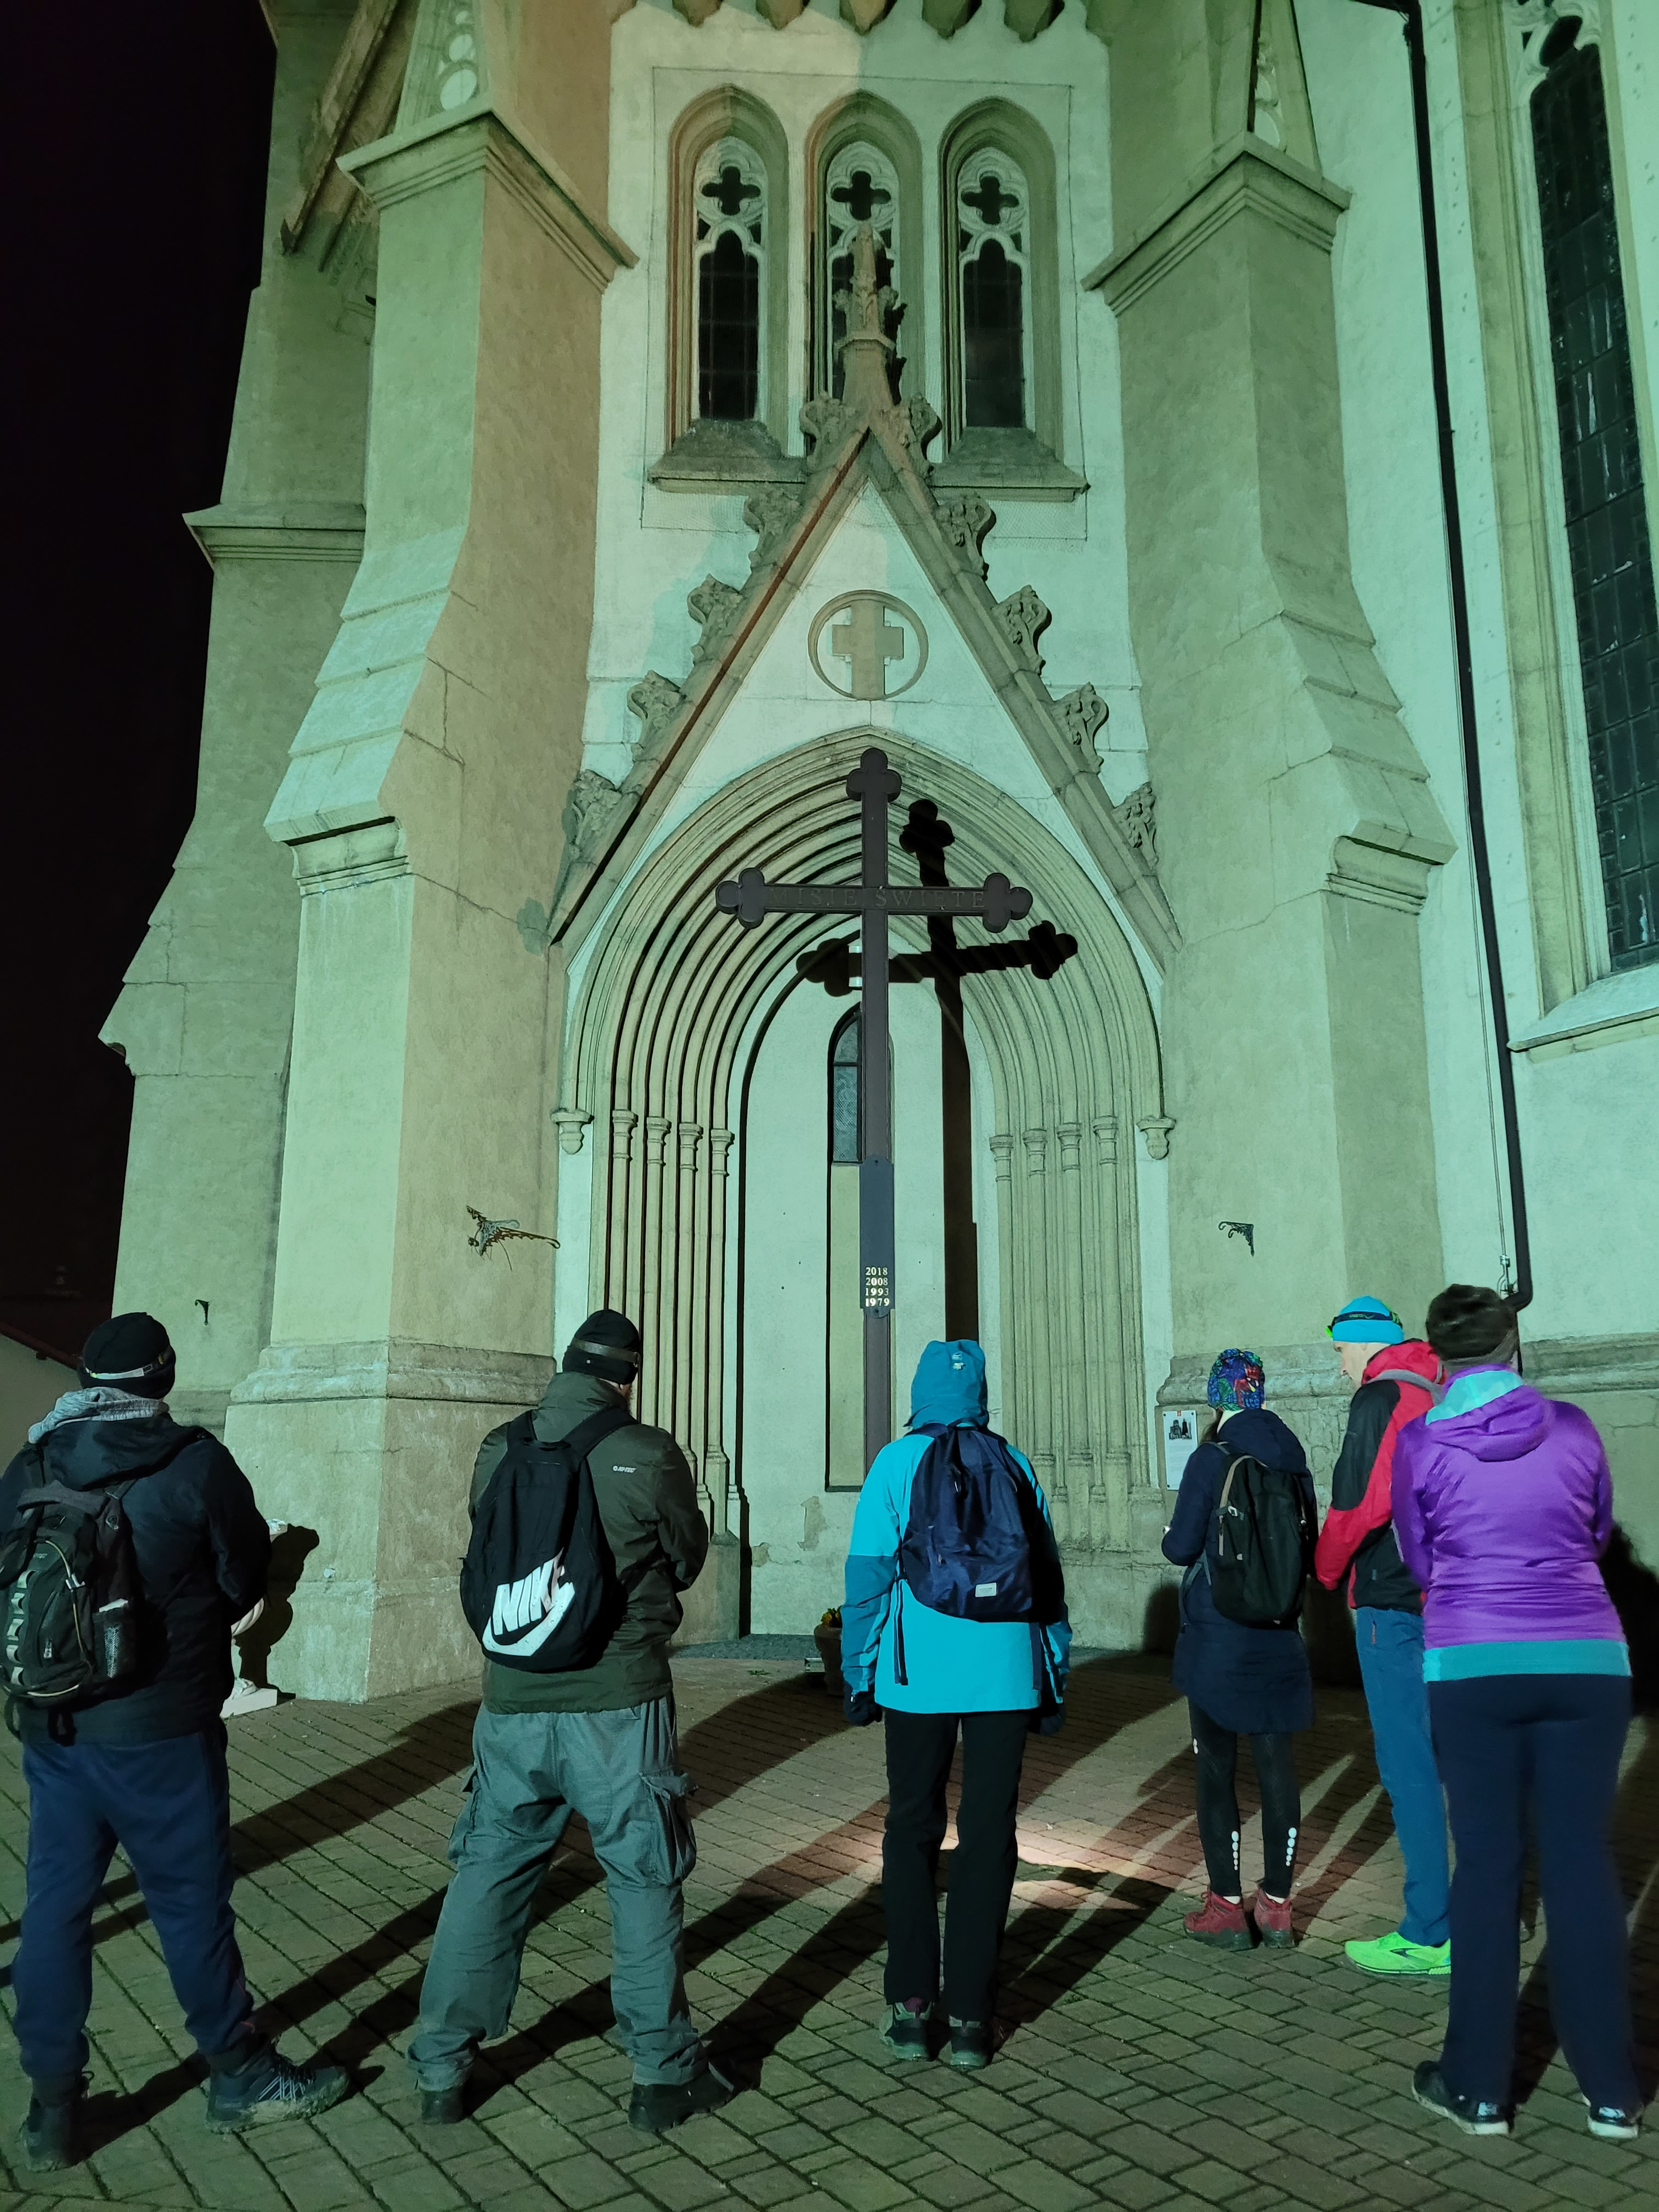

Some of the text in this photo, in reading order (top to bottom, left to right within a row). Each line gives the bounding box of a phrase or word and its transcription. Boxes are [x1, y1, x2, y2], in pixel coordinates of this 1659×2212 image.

[865, 1267, 888, 1276] 2018
[865, 1277, 888, 1286] 2008
[865, 1288, 889, 1296] 1993
[865, 1298, 889, 1307] 1979
